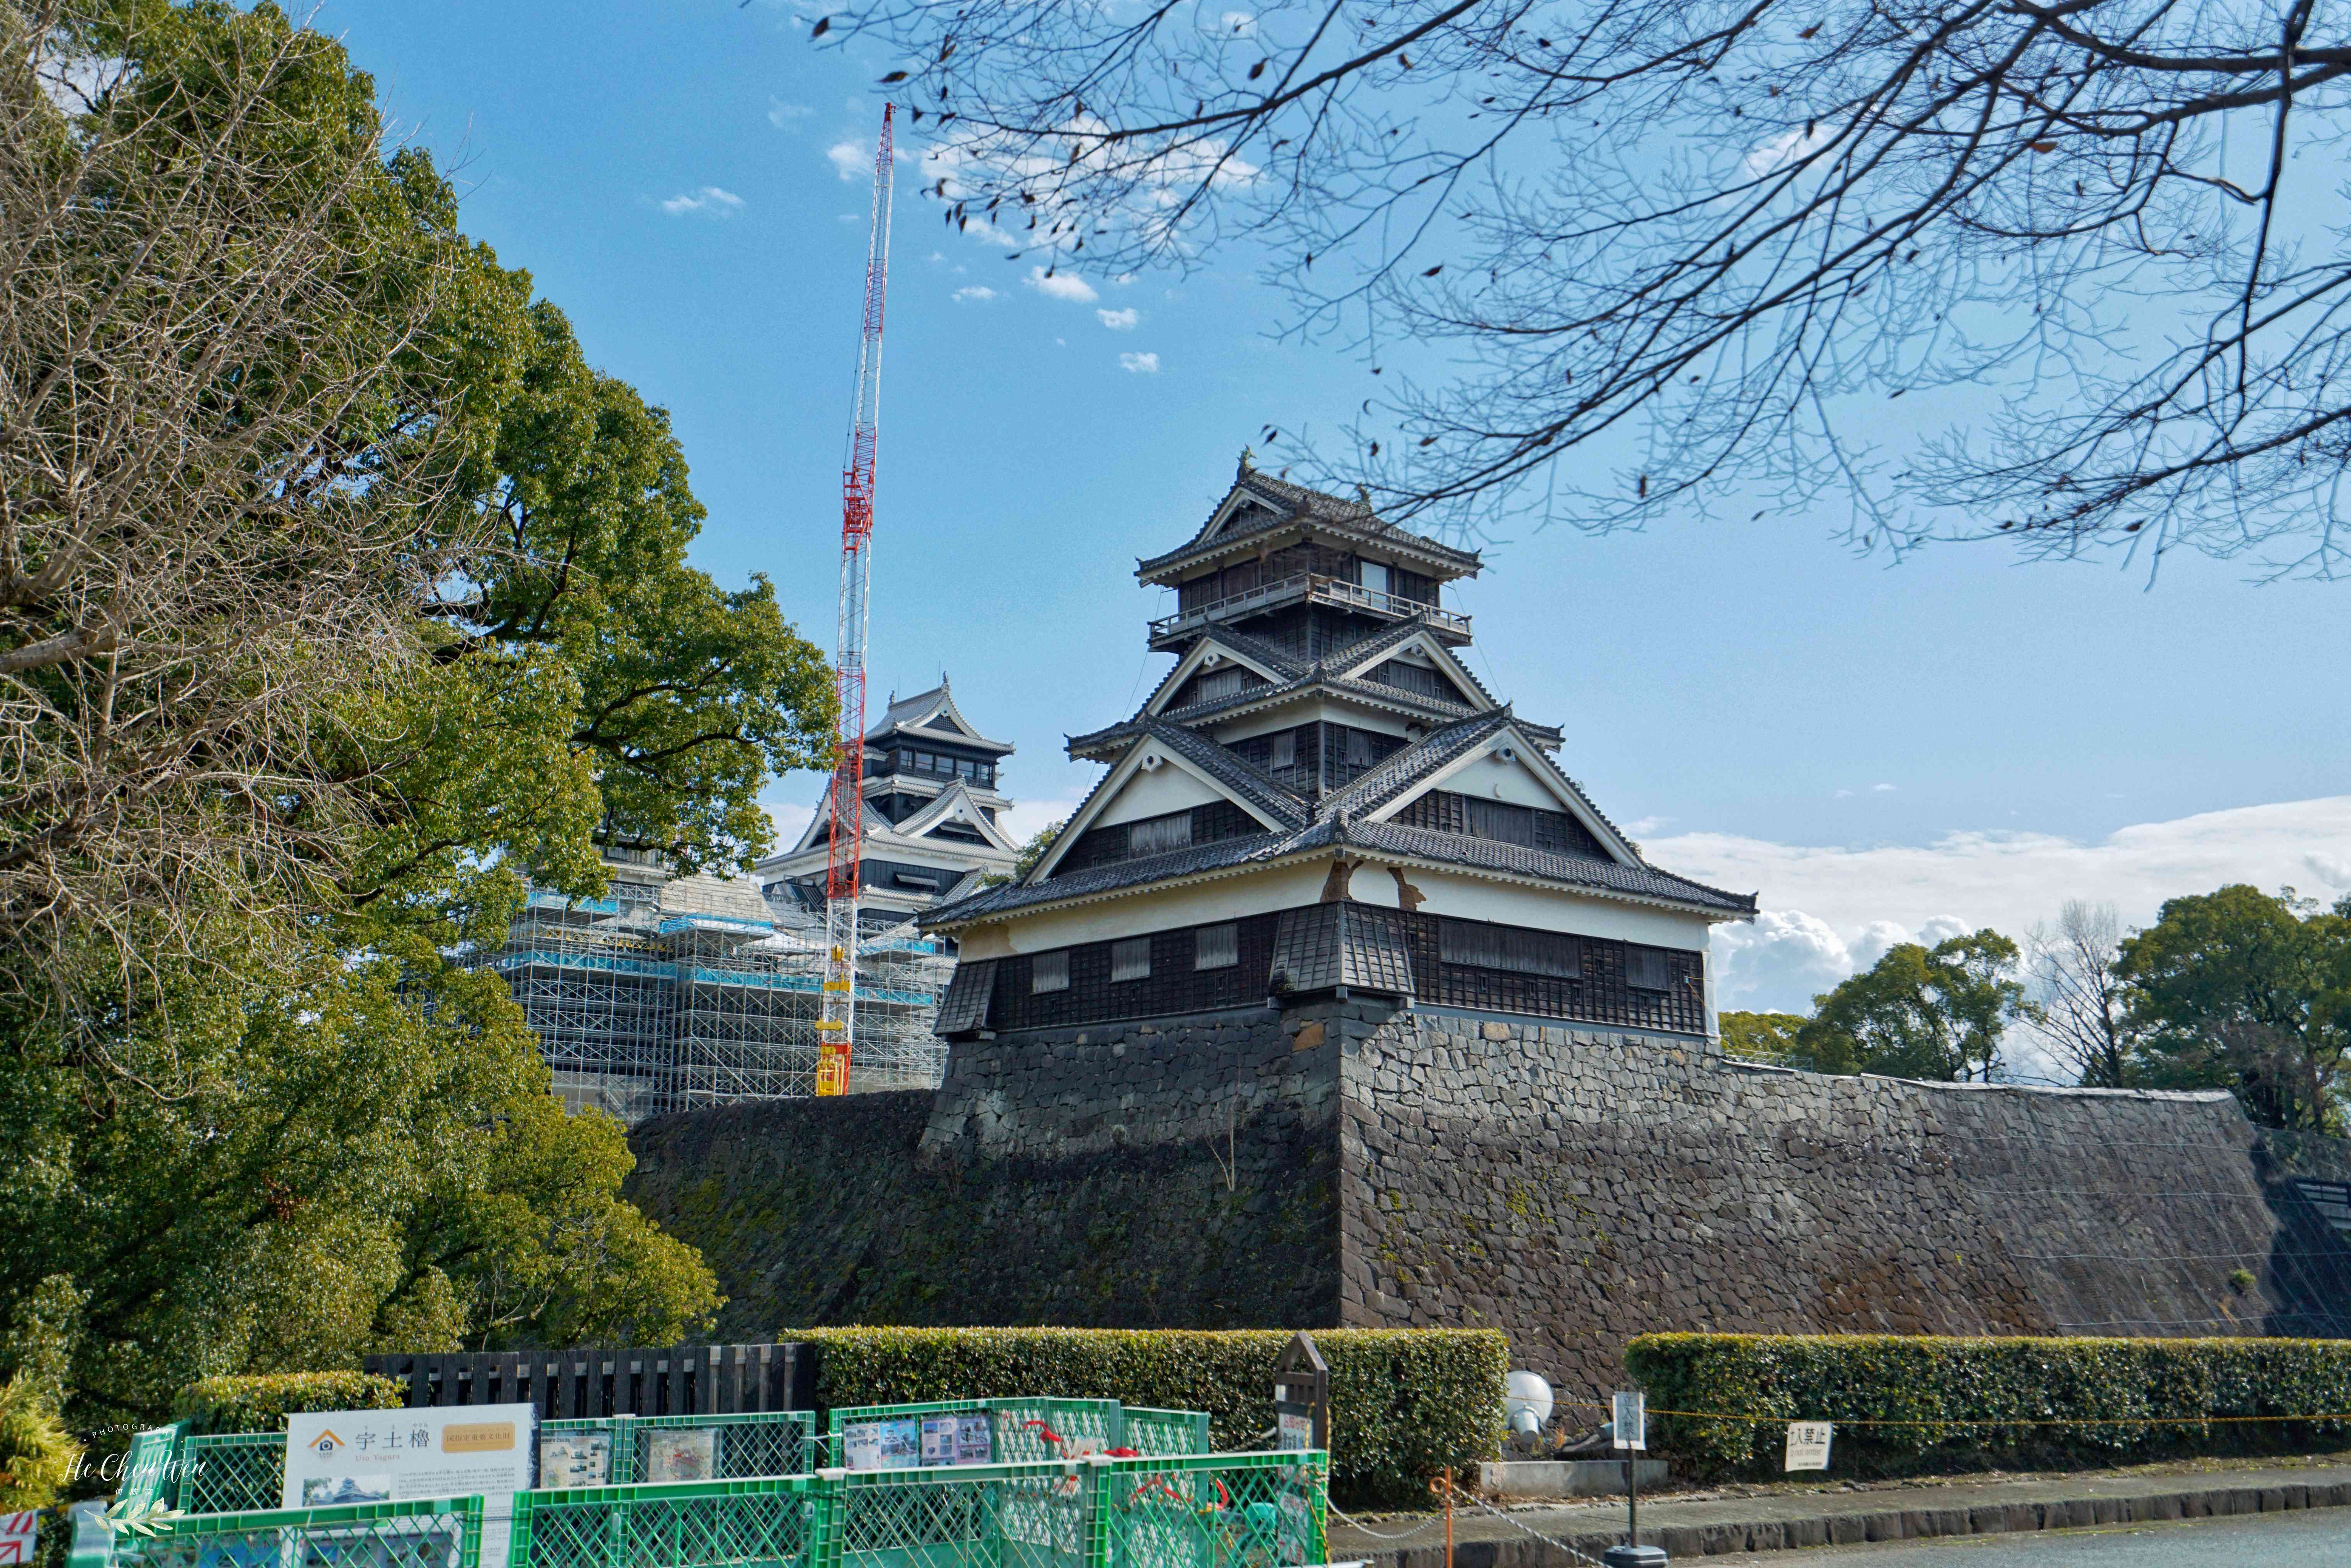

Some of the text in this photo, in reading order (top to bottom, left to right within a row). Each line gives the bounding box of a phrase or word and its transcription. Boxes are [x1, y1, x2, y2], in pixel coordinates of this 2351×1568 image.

[355, 1429, 429, 1450] 宇土櫓
[446, 1432, 510, 1442] 国指定重要文化財
[1805, 1448, 1822, 1456] enter
